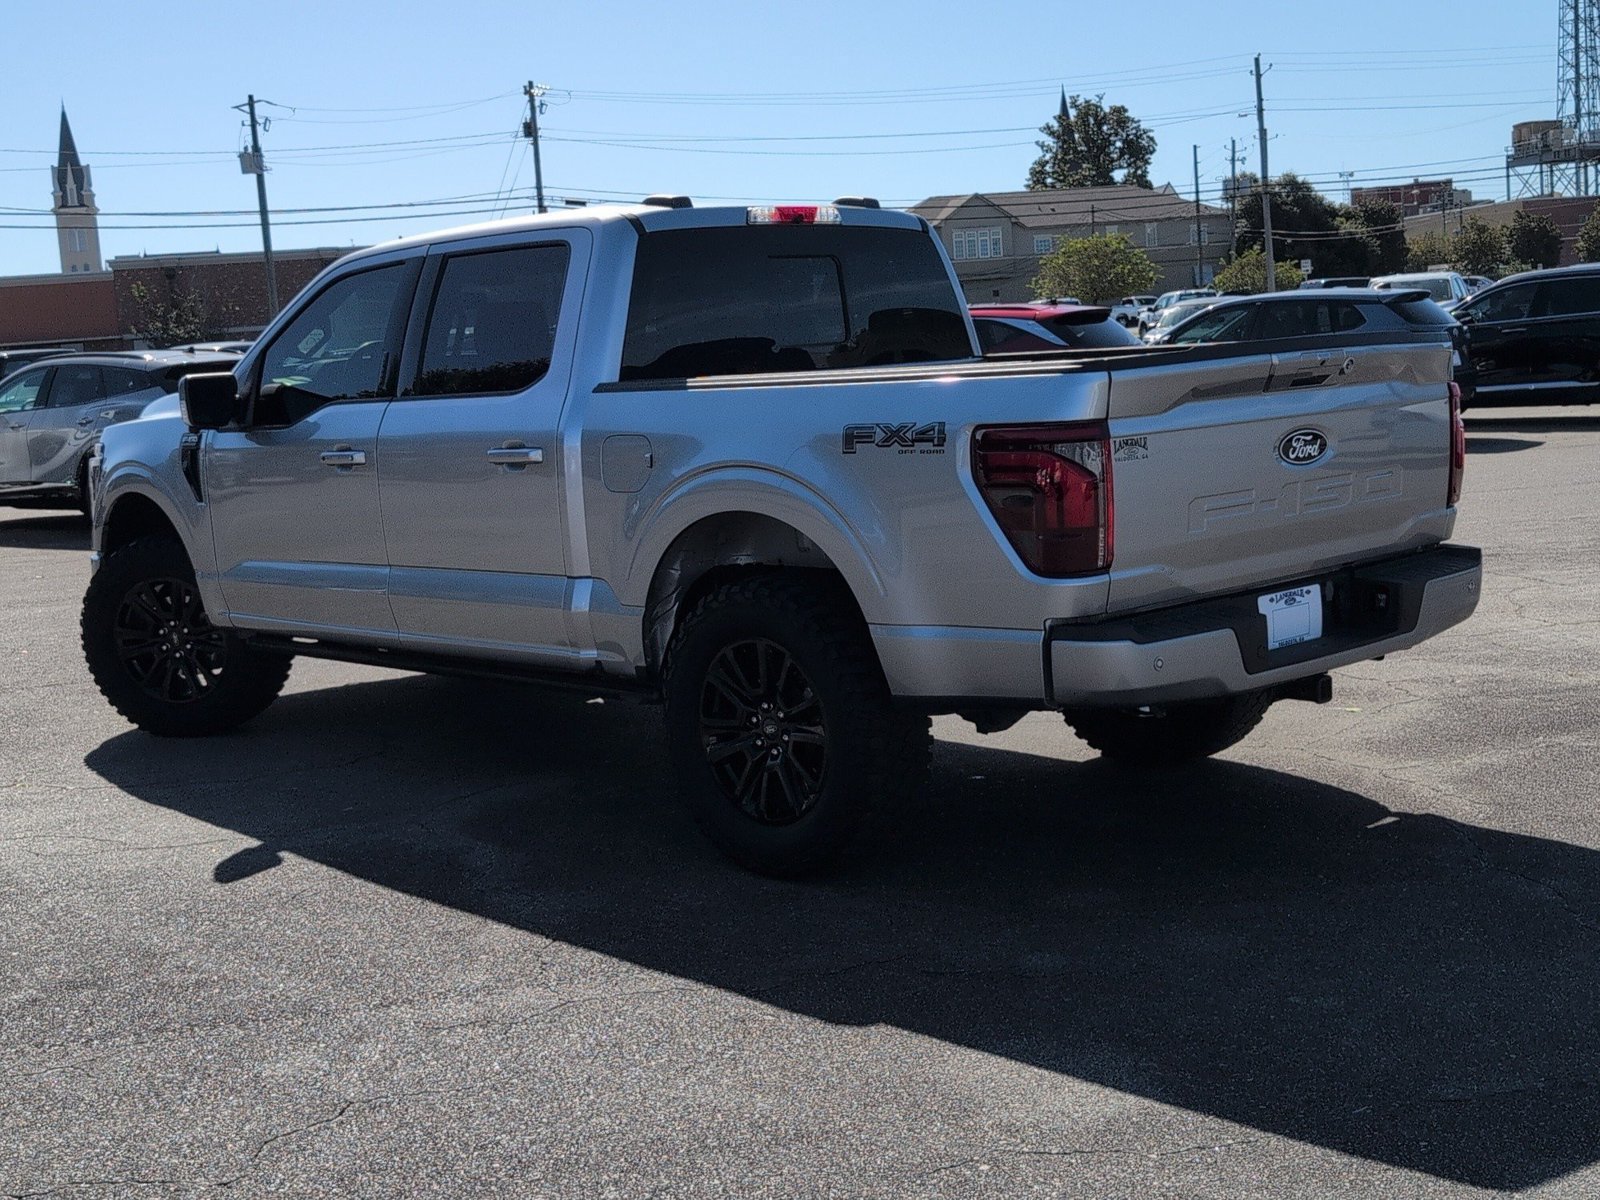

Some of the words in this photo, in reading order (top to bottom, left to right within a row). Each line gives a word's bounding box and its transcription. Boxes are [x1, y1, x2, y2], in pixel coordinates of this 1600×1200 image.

[842, 422, 946, 454] FX4
[1113, 436, 1148, 454] LANGDALE
[1289, 435, 1320, 459] Ford
[1186, 464, 1403, 534] F-150
[1275, 589, 1305, 605] LANGDALE
